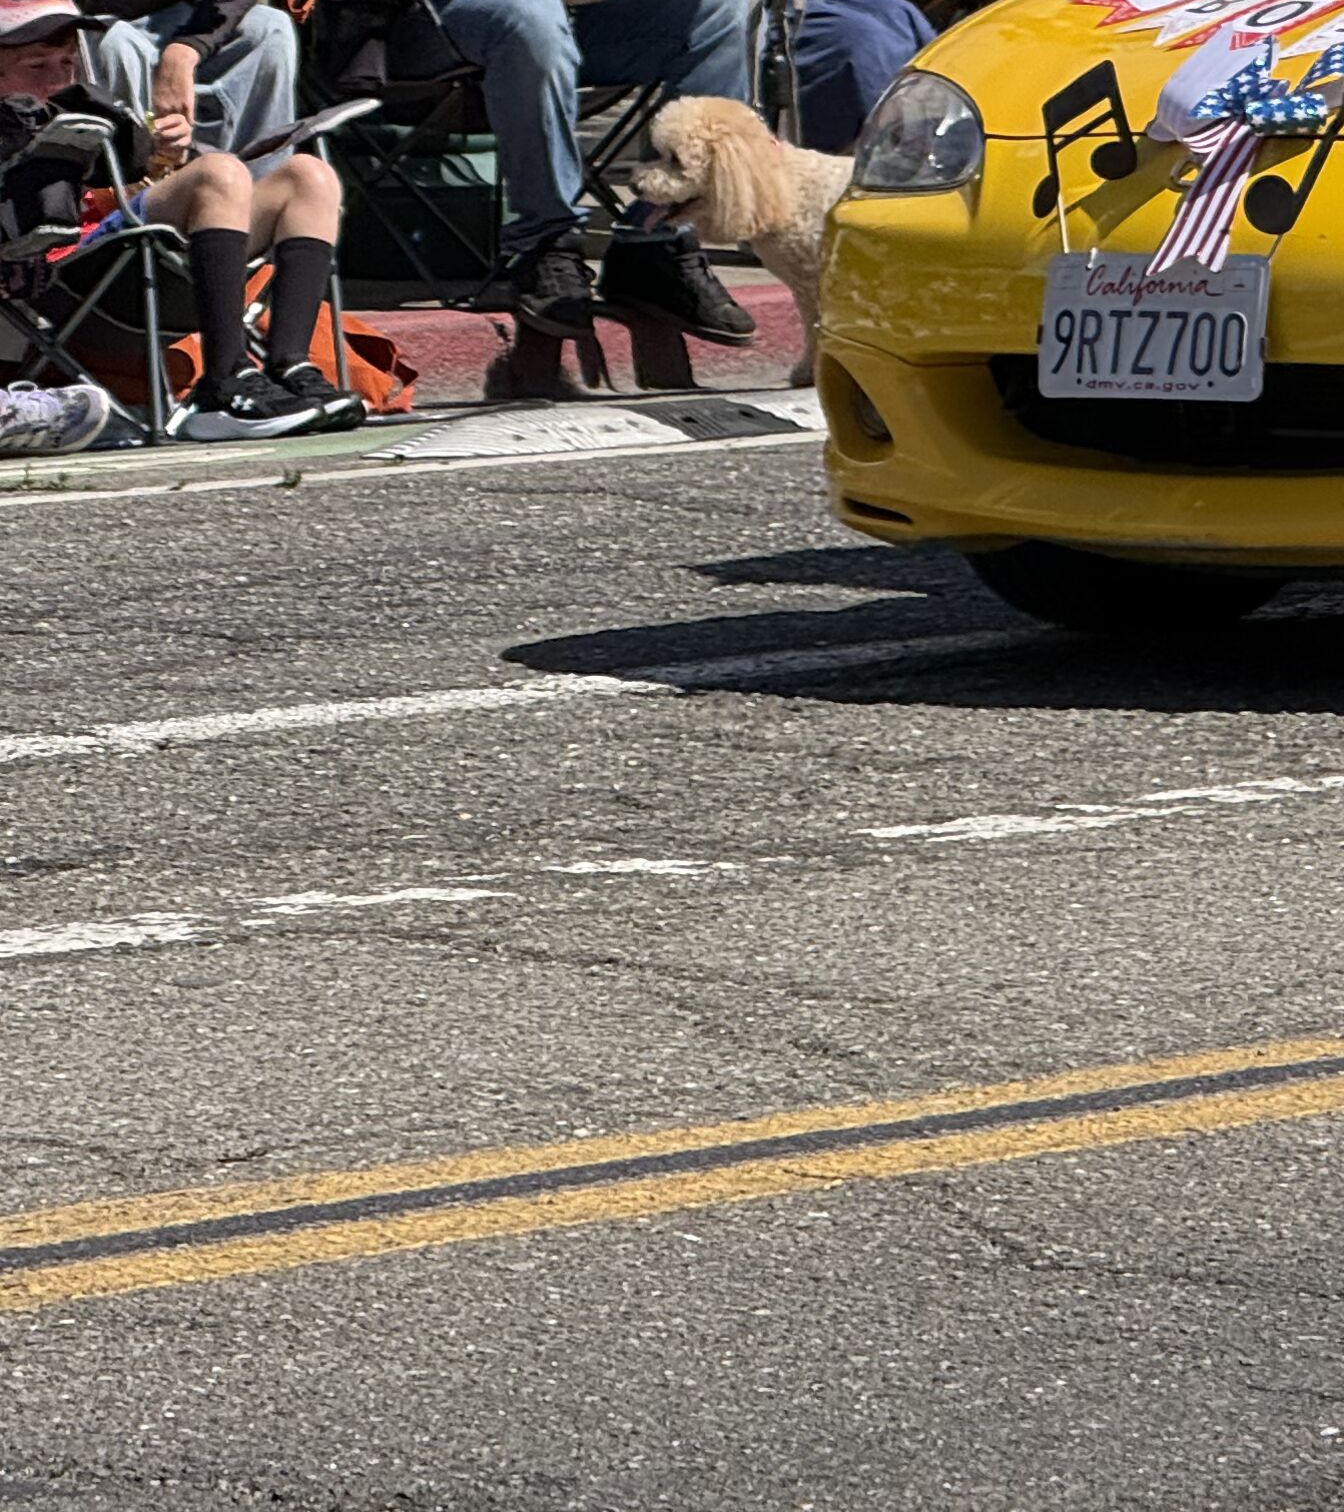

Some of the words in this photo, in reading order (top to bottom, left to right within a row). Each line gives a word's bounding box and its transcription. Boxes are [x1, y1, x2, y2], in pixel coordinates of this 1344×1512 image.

[1085, 263, 1225, 306] California
[1050, 308, 1249, 379] 9RTZ700
[1085, 379, 1202, 393] dmv.ca.gov
